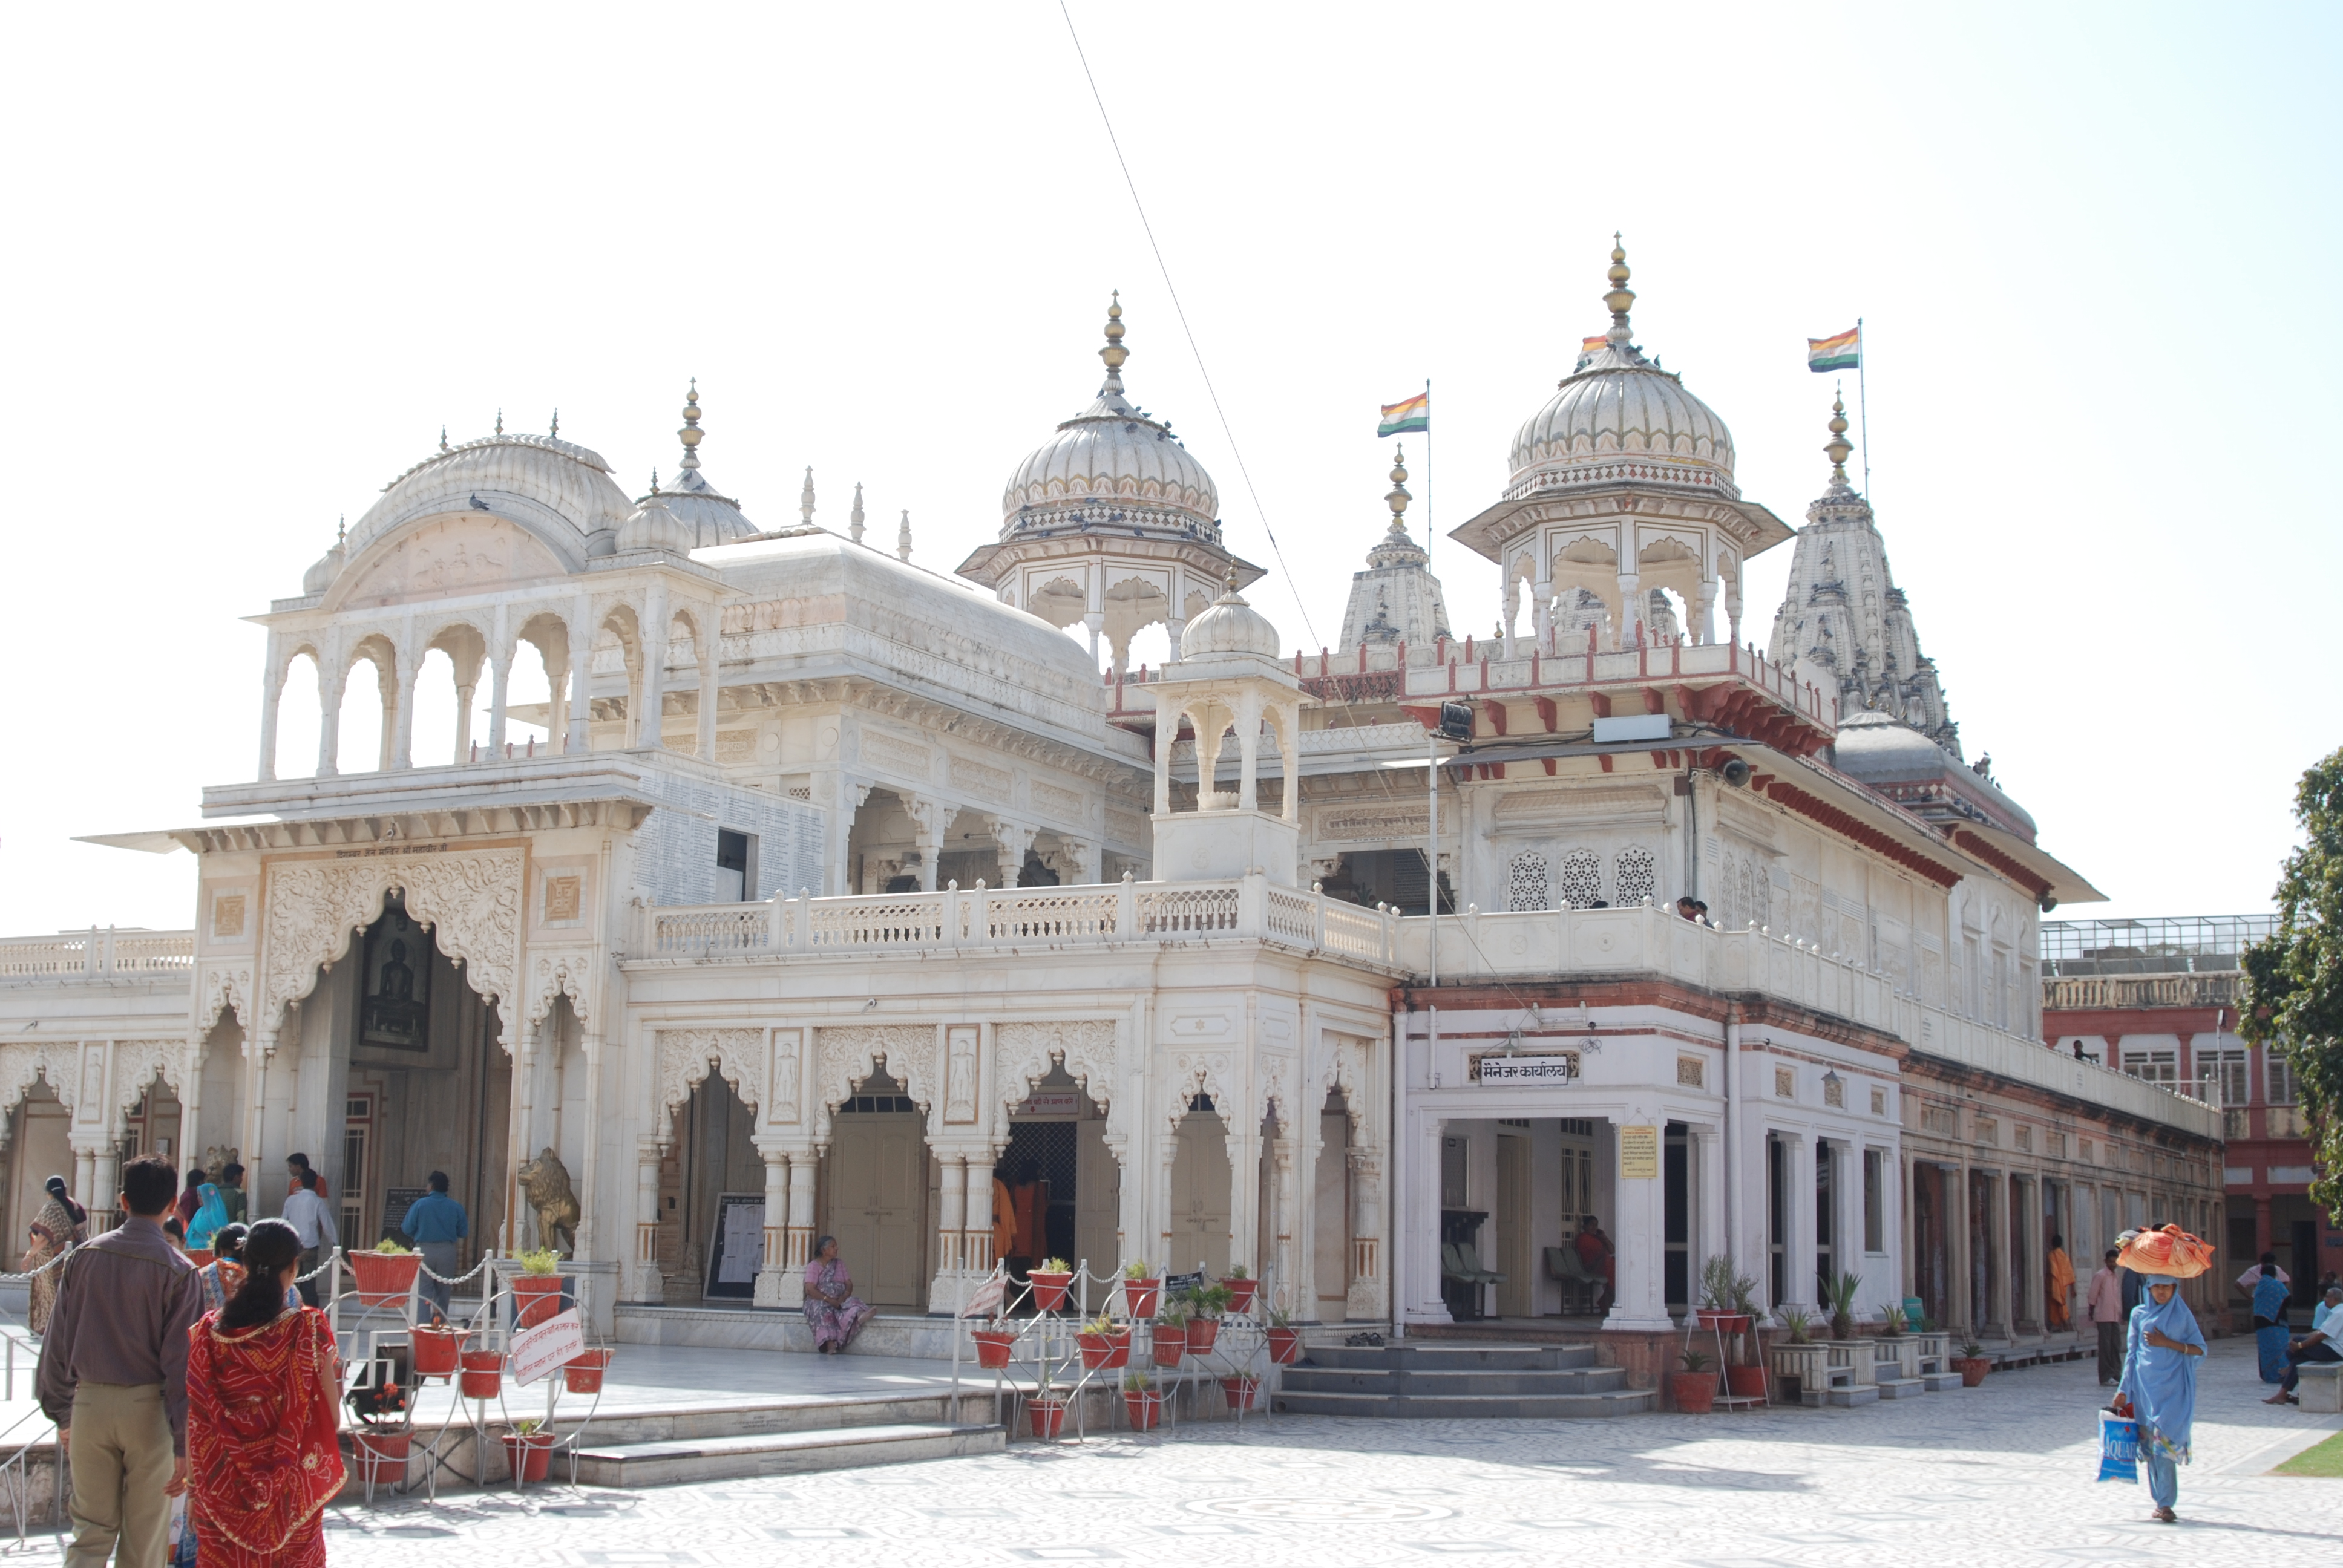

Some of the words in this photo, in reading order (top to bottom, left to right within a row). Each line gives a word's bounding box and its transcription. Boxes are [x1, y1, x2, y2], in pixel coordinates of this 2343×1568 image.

[336, 850, 361, 858] दिगम्बर
[364, 848, 376, 857] जैन
[379, 846, 399, 855] मन्दिर
[403, 845, 411, 854] श्री
[412, 844, 437, 853] महावीर
[438, 843, 447, 852] जी
[1483, 1062, 1518, 1078] मैनेजर
[1520, 1061, 1566, 1077] कार्यालय
